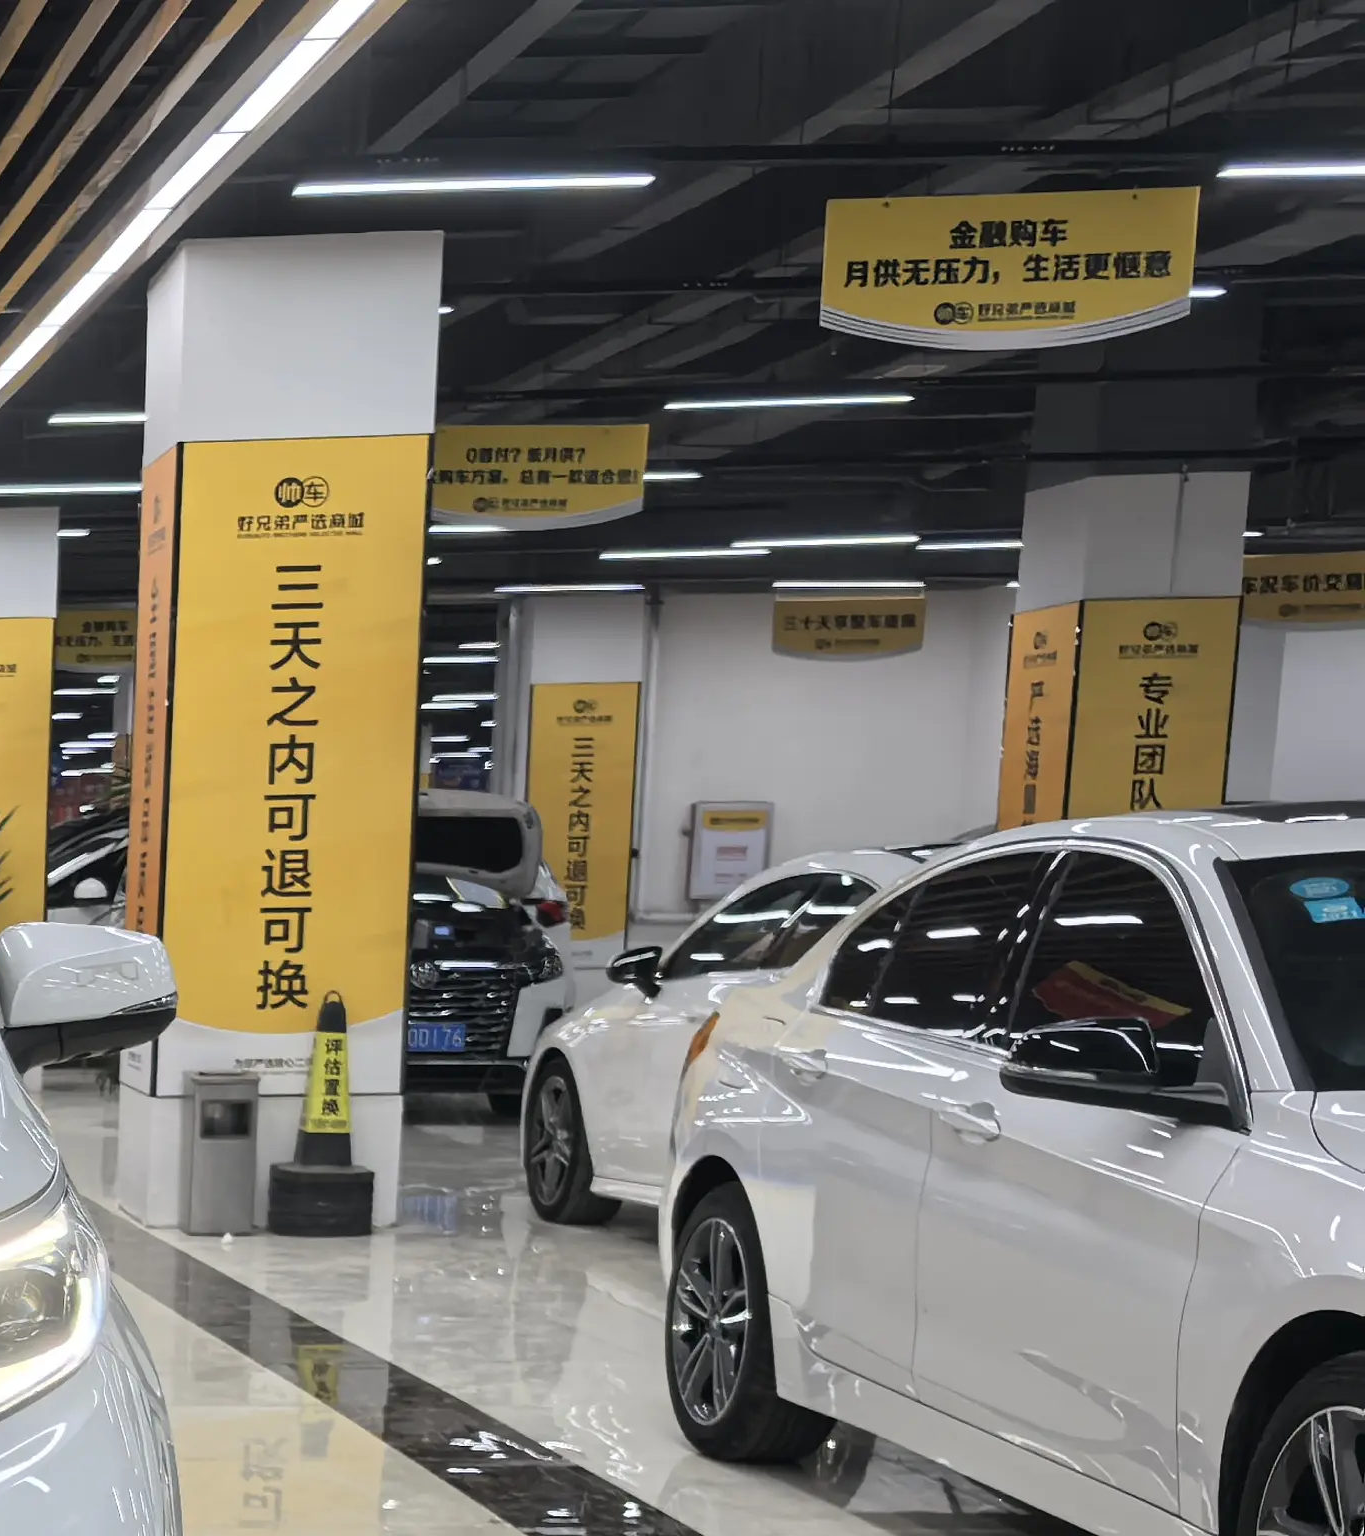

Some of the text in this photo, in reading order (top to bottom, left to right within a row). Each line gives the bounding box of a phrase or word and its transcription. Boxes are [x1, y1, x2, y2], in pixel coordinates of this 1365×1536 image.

[949, 219, 1069, 249] 金融购车
[237, 512, 365, 531] 好兄弟严选商城
[1130, 673, 1173, 810] 专业团队
[256, 564, 324, 1011] 三天之内可退可换
[321, 1038, 343, 1117] 评估置换
